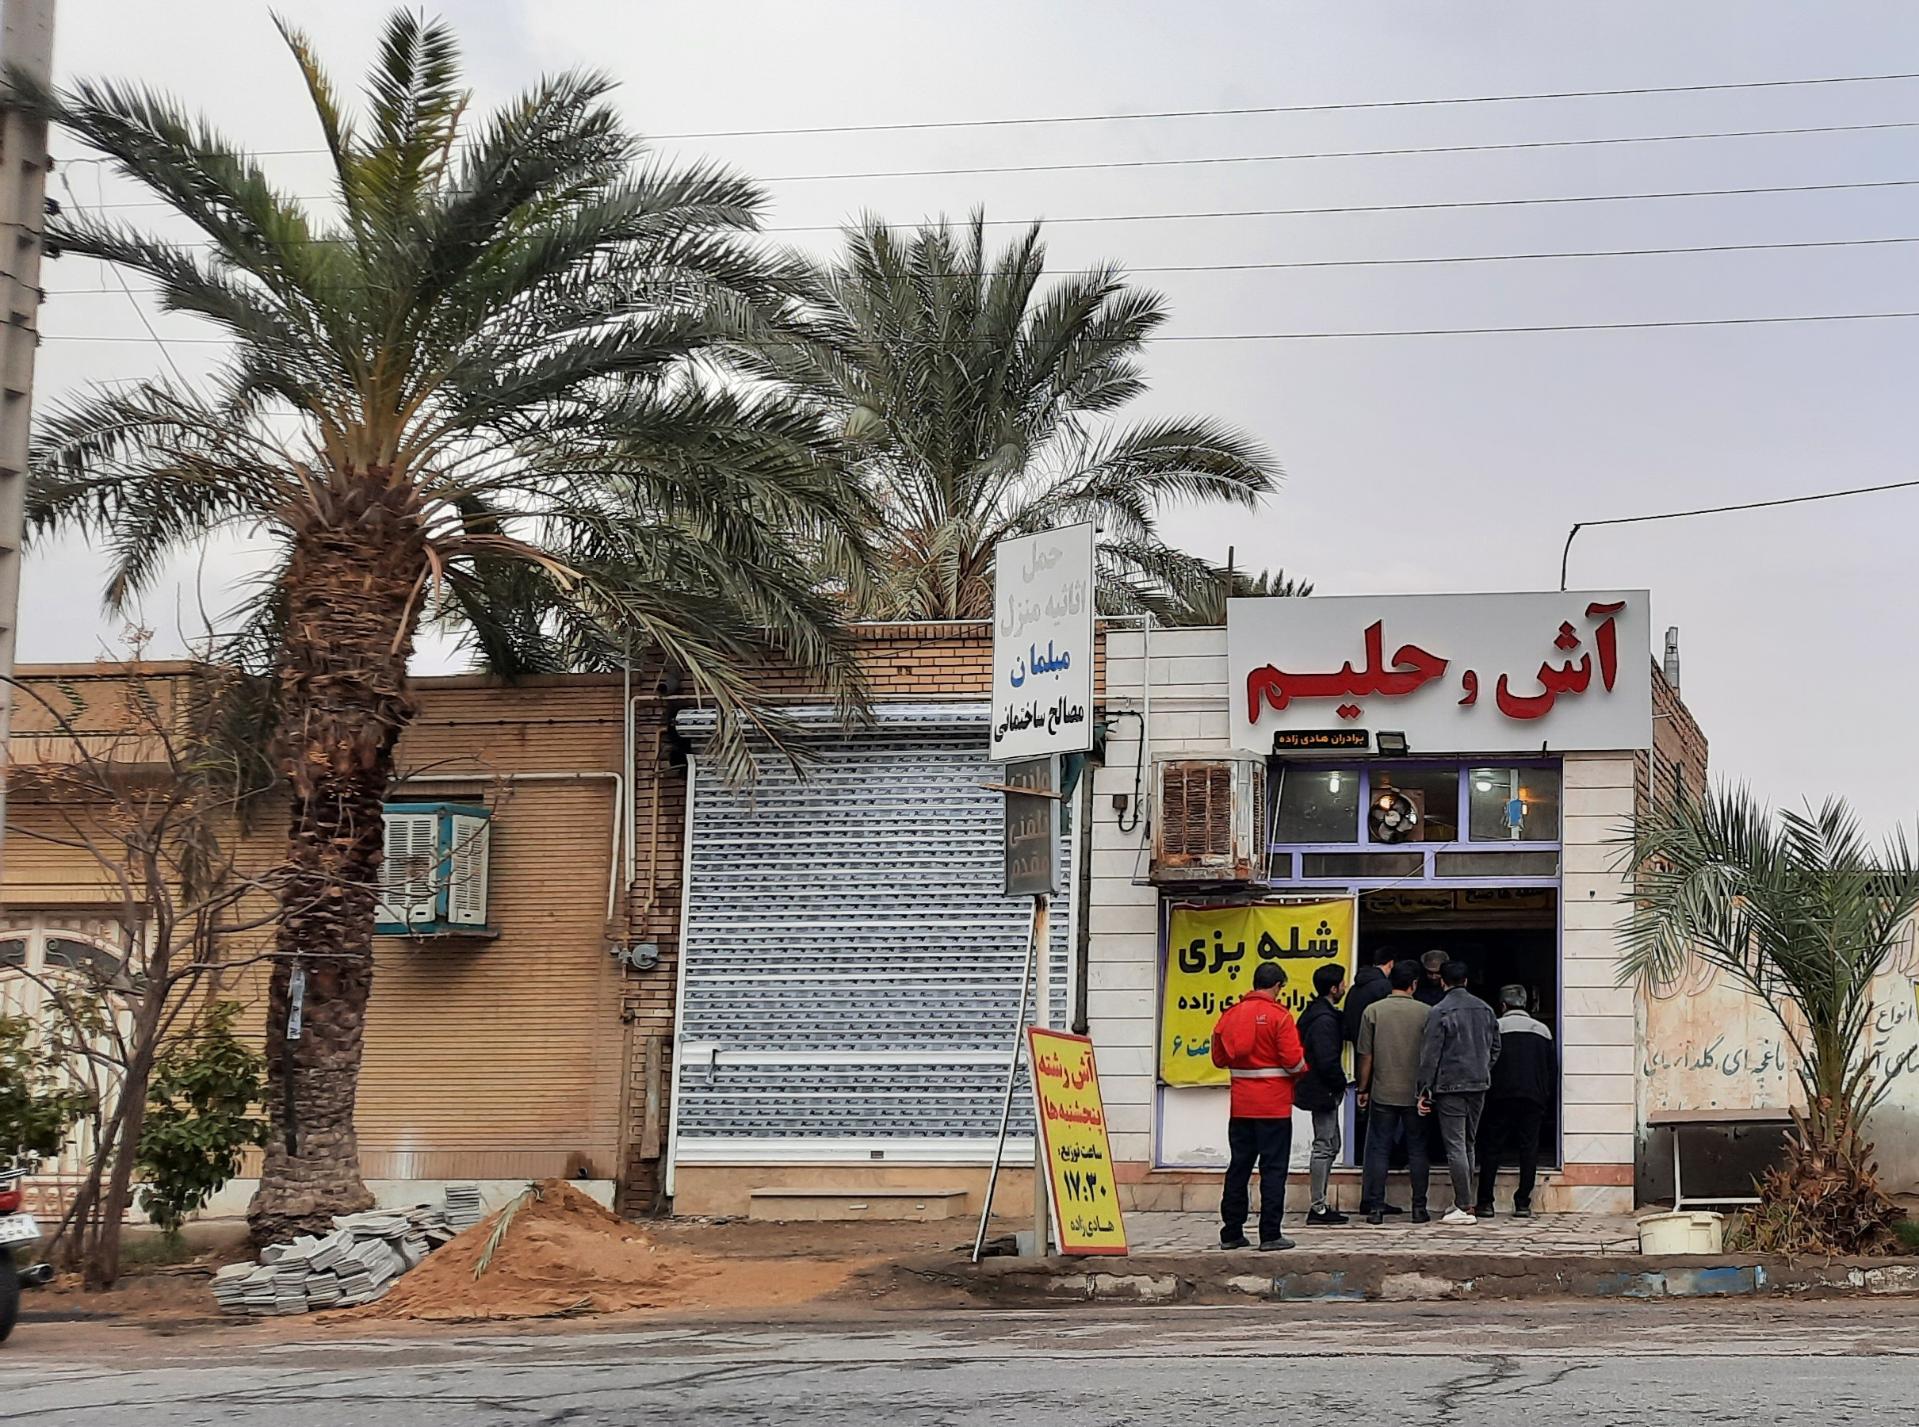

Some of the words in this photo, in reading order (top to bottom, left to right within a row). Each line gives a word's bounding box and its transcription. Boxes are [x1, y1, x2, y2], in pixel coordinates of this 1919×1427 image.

[1022, 540, 1064, 584] حمل
[1000, 594, 1041, 638] منزل
[1045, 580, 1087, 626] اثاثیه
[1010, 640, 1071, 688] مبلمان
[1246, 618, 1450, 726] حلیم
[1496, 601, 1626, 720] آش
[1458, 669, 1478, 705] و
[994, 700, 1045, 743] ساختمانی
[1048, 695, 1085, 736] مصالح
[1279, 735, 1298, 745] زاده
[1300, 734, 1329, 745] هادی
[1331, 734, 1365, 745] برادران
[1178, 930, 1246, 980] پزی
[1256, 920, 1339, 960] شله
[1177, 992, 1215, 1015] زاده
[1038, 1052, 1070, 1089] رشته
[1072, 1051, 1094, 1090] آش
[1063, 1169, 1107, 1203] ۱۷:۳۰
